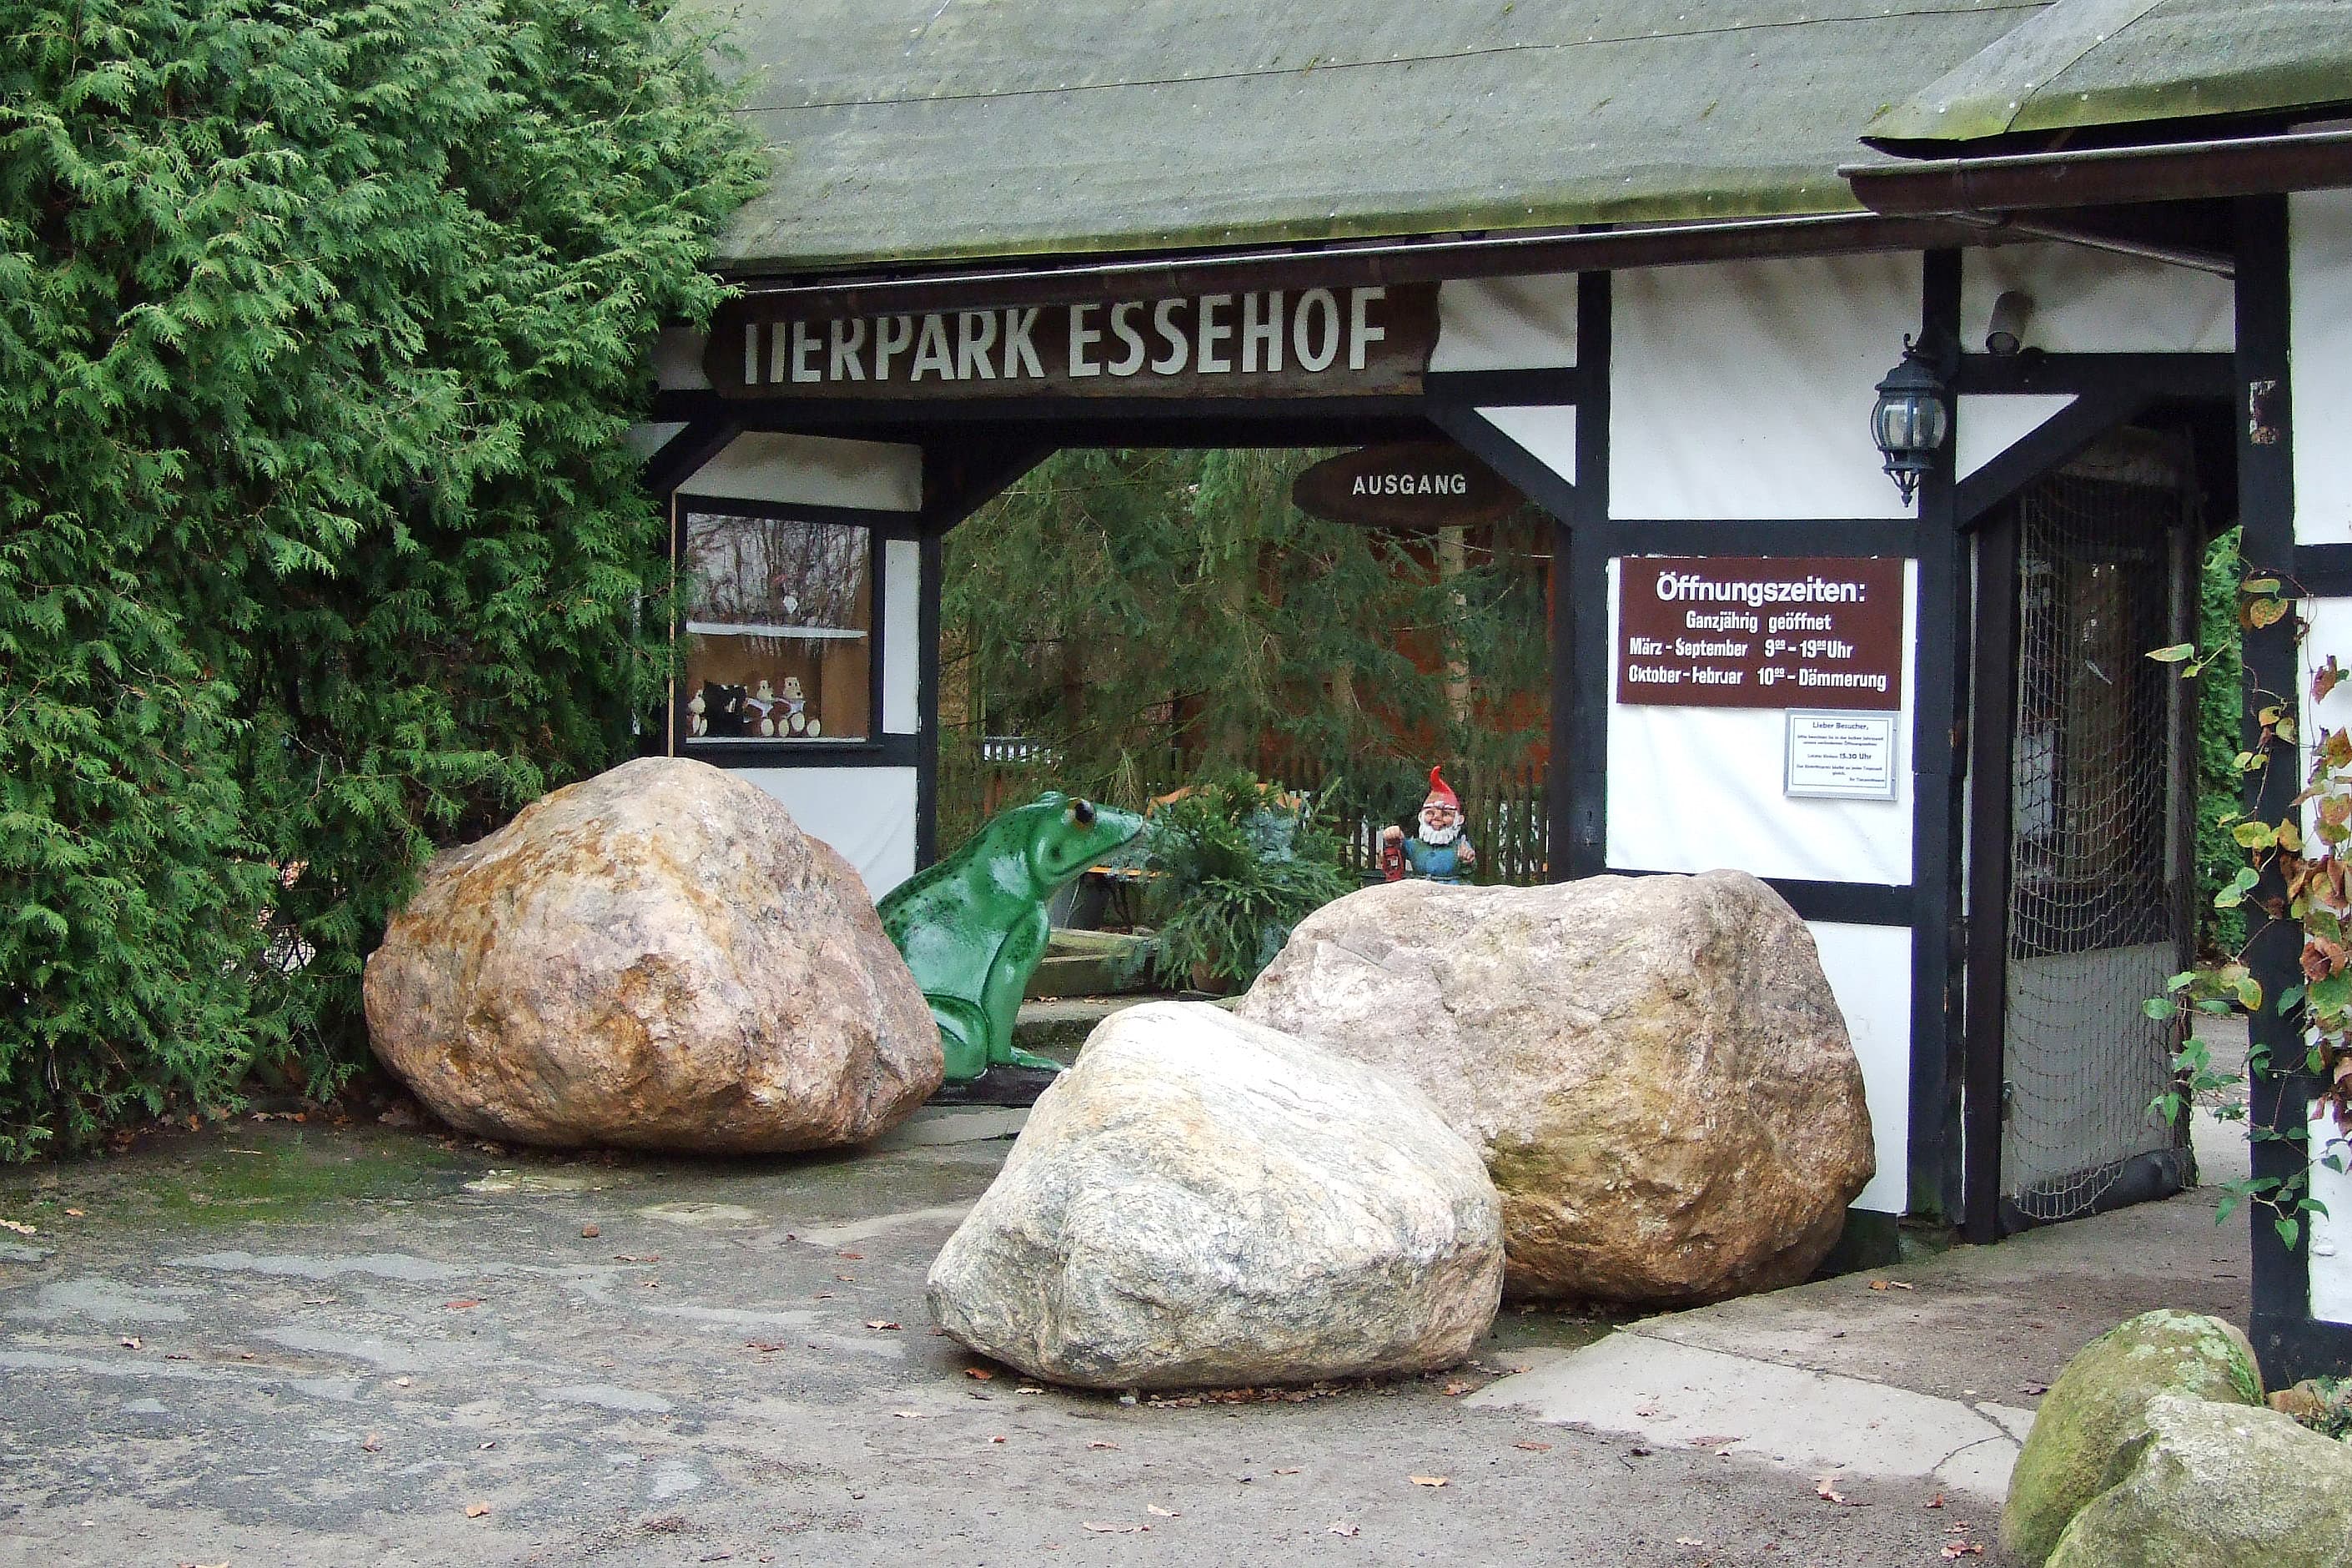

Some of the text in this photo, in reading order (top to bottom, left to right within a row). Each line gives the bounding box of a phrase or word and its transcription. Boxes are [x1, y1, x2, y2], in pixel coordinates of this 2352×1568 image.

[1068, 287, 1386, 377] ESSEHOF
[1352, 473, 1467, 495] AUSGANG
[1656, 571, 1867, 607] Öffnungszeiten:
[1686, 611, 1832, 633] Ganzjährig geöffnet
[1629, 637, 1662, 656] März
[1675, 637, 1748, 659] September
[1798, 667, 1887, 692] Dämmerung
